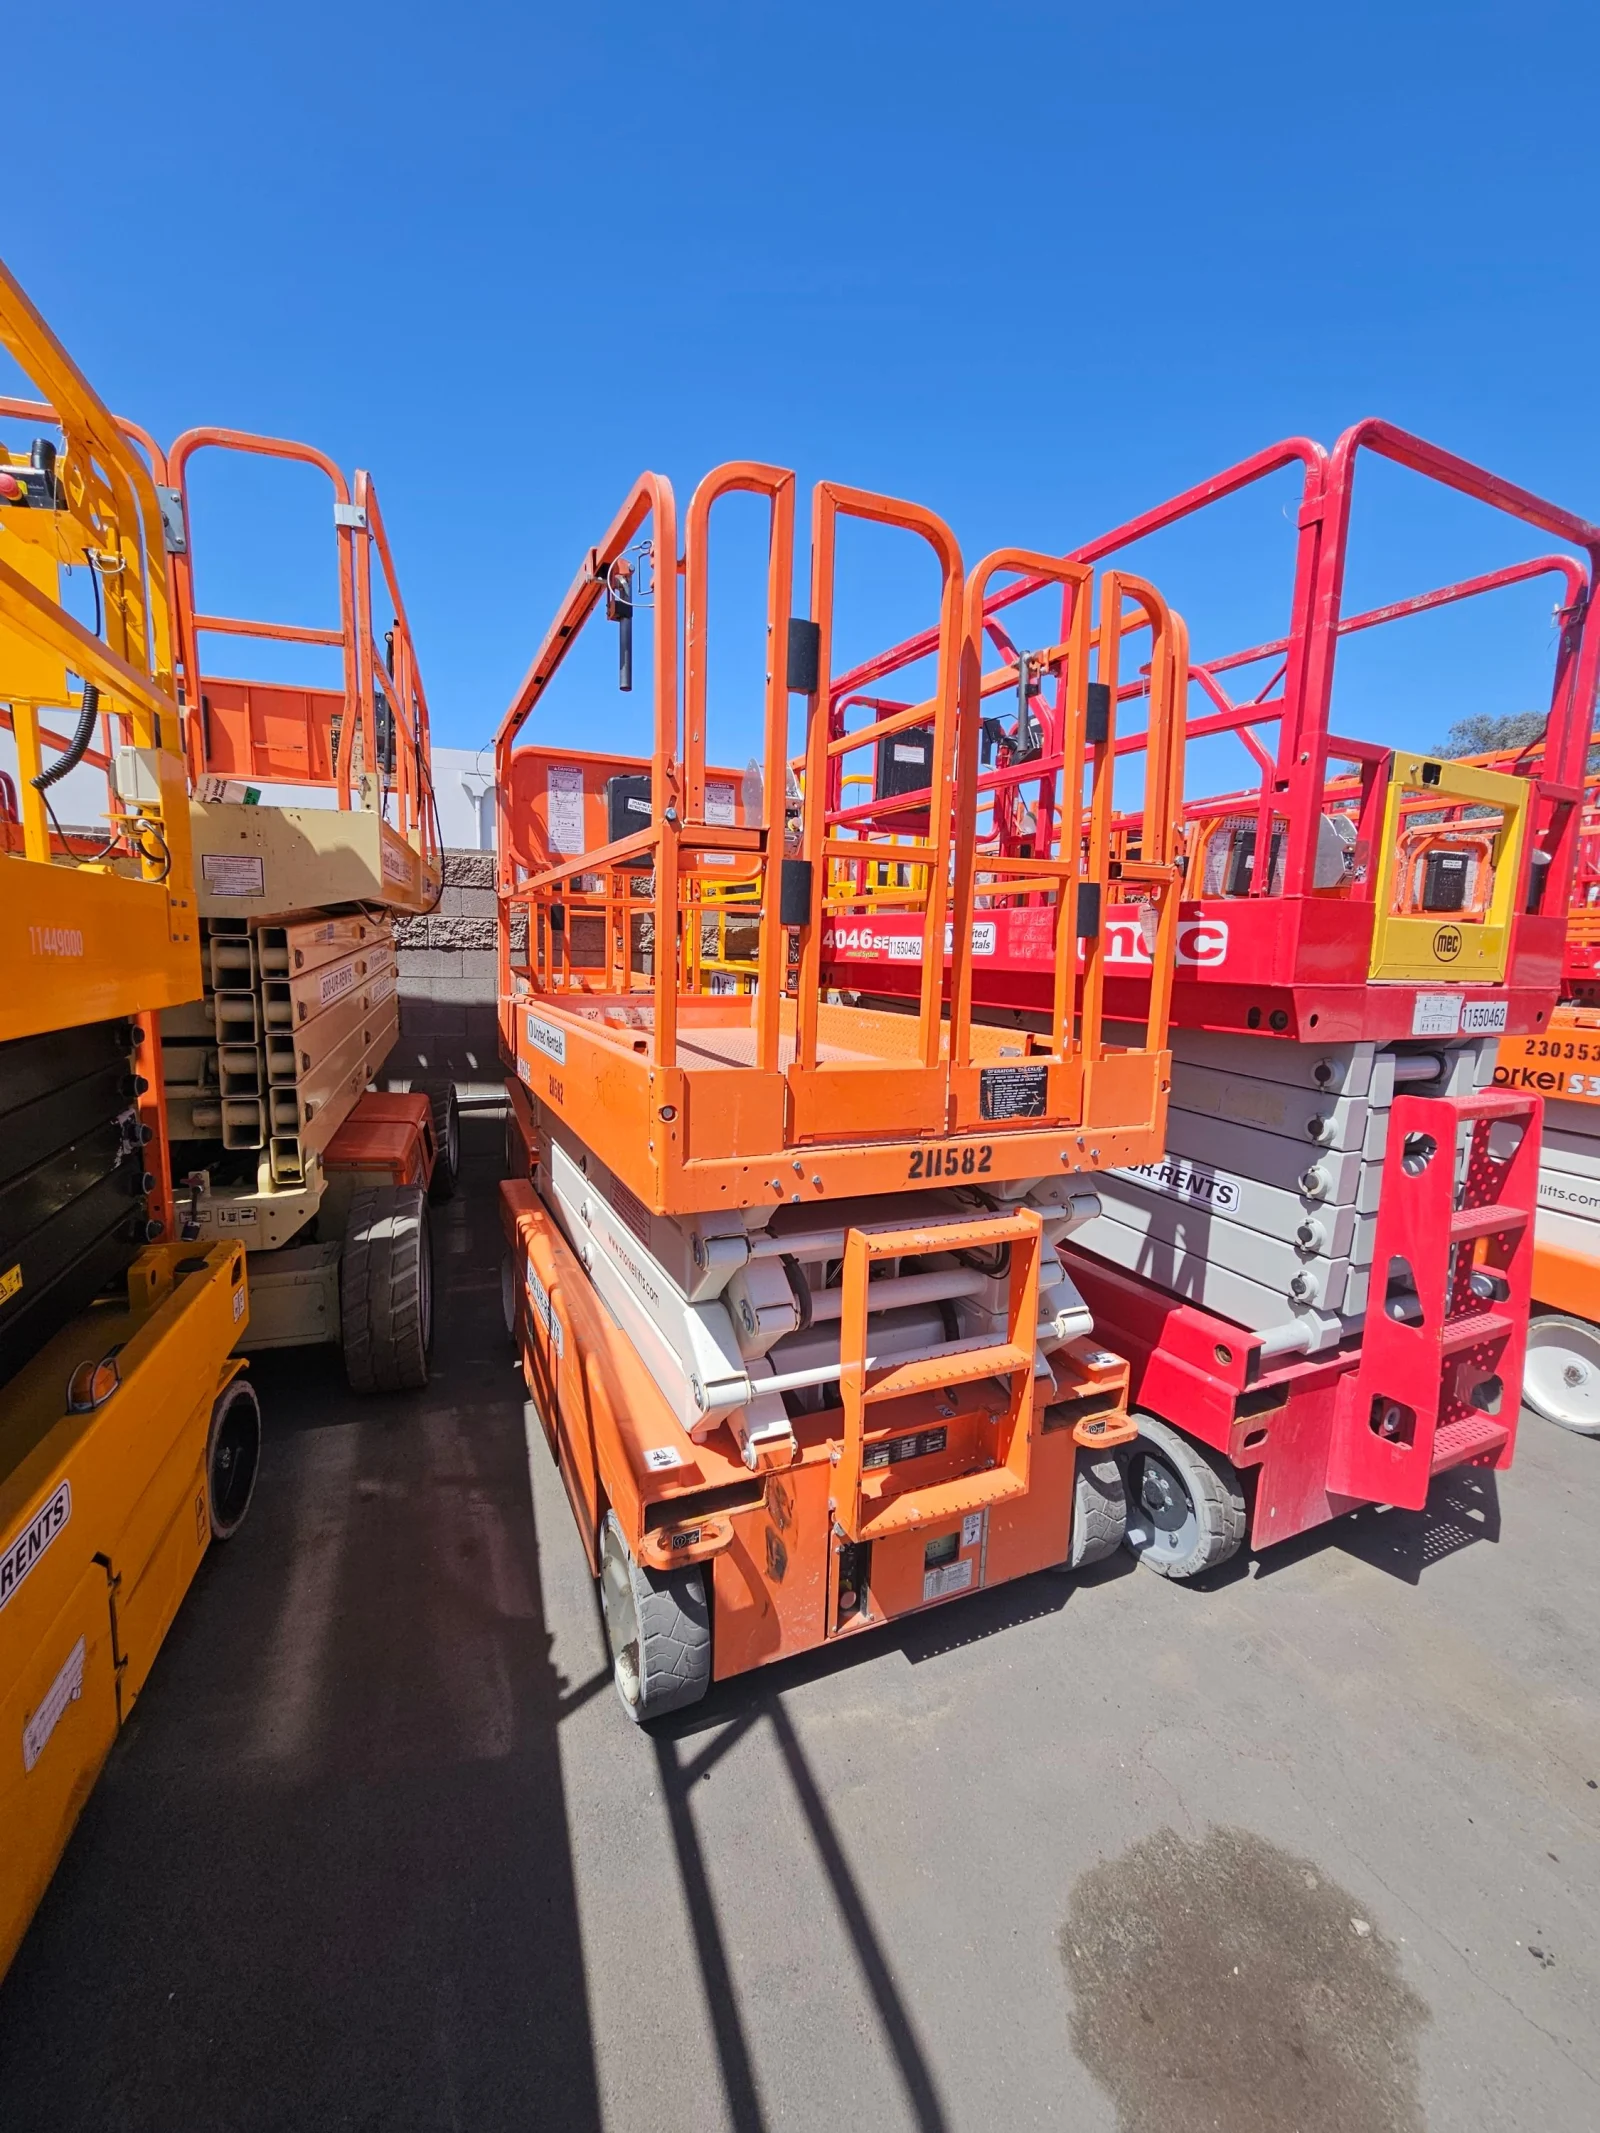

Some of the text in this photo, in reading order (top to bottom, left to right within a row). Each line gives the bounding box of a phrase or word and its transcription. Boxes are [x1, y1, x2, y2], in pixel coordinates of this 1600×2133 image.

[972, 928, 989, 938] ited
[972, 940, 991, 949] tals
[1081, 926, 1225, 961] mc
[1436, 934, 1459, 953] mec
[890, 941, 921, 956] 11550462
[1462, 1007, 1506, 1028] 11550462
[533, 1023, 563, 1056] United Rentals
[1525, 1039, 1600, 1062] 230353
[908, 1145, 993, 1179] 211582
[1539, 1184, 1600, 1208] lifts.com
[0, 1494, 65, 1598] RENTS
